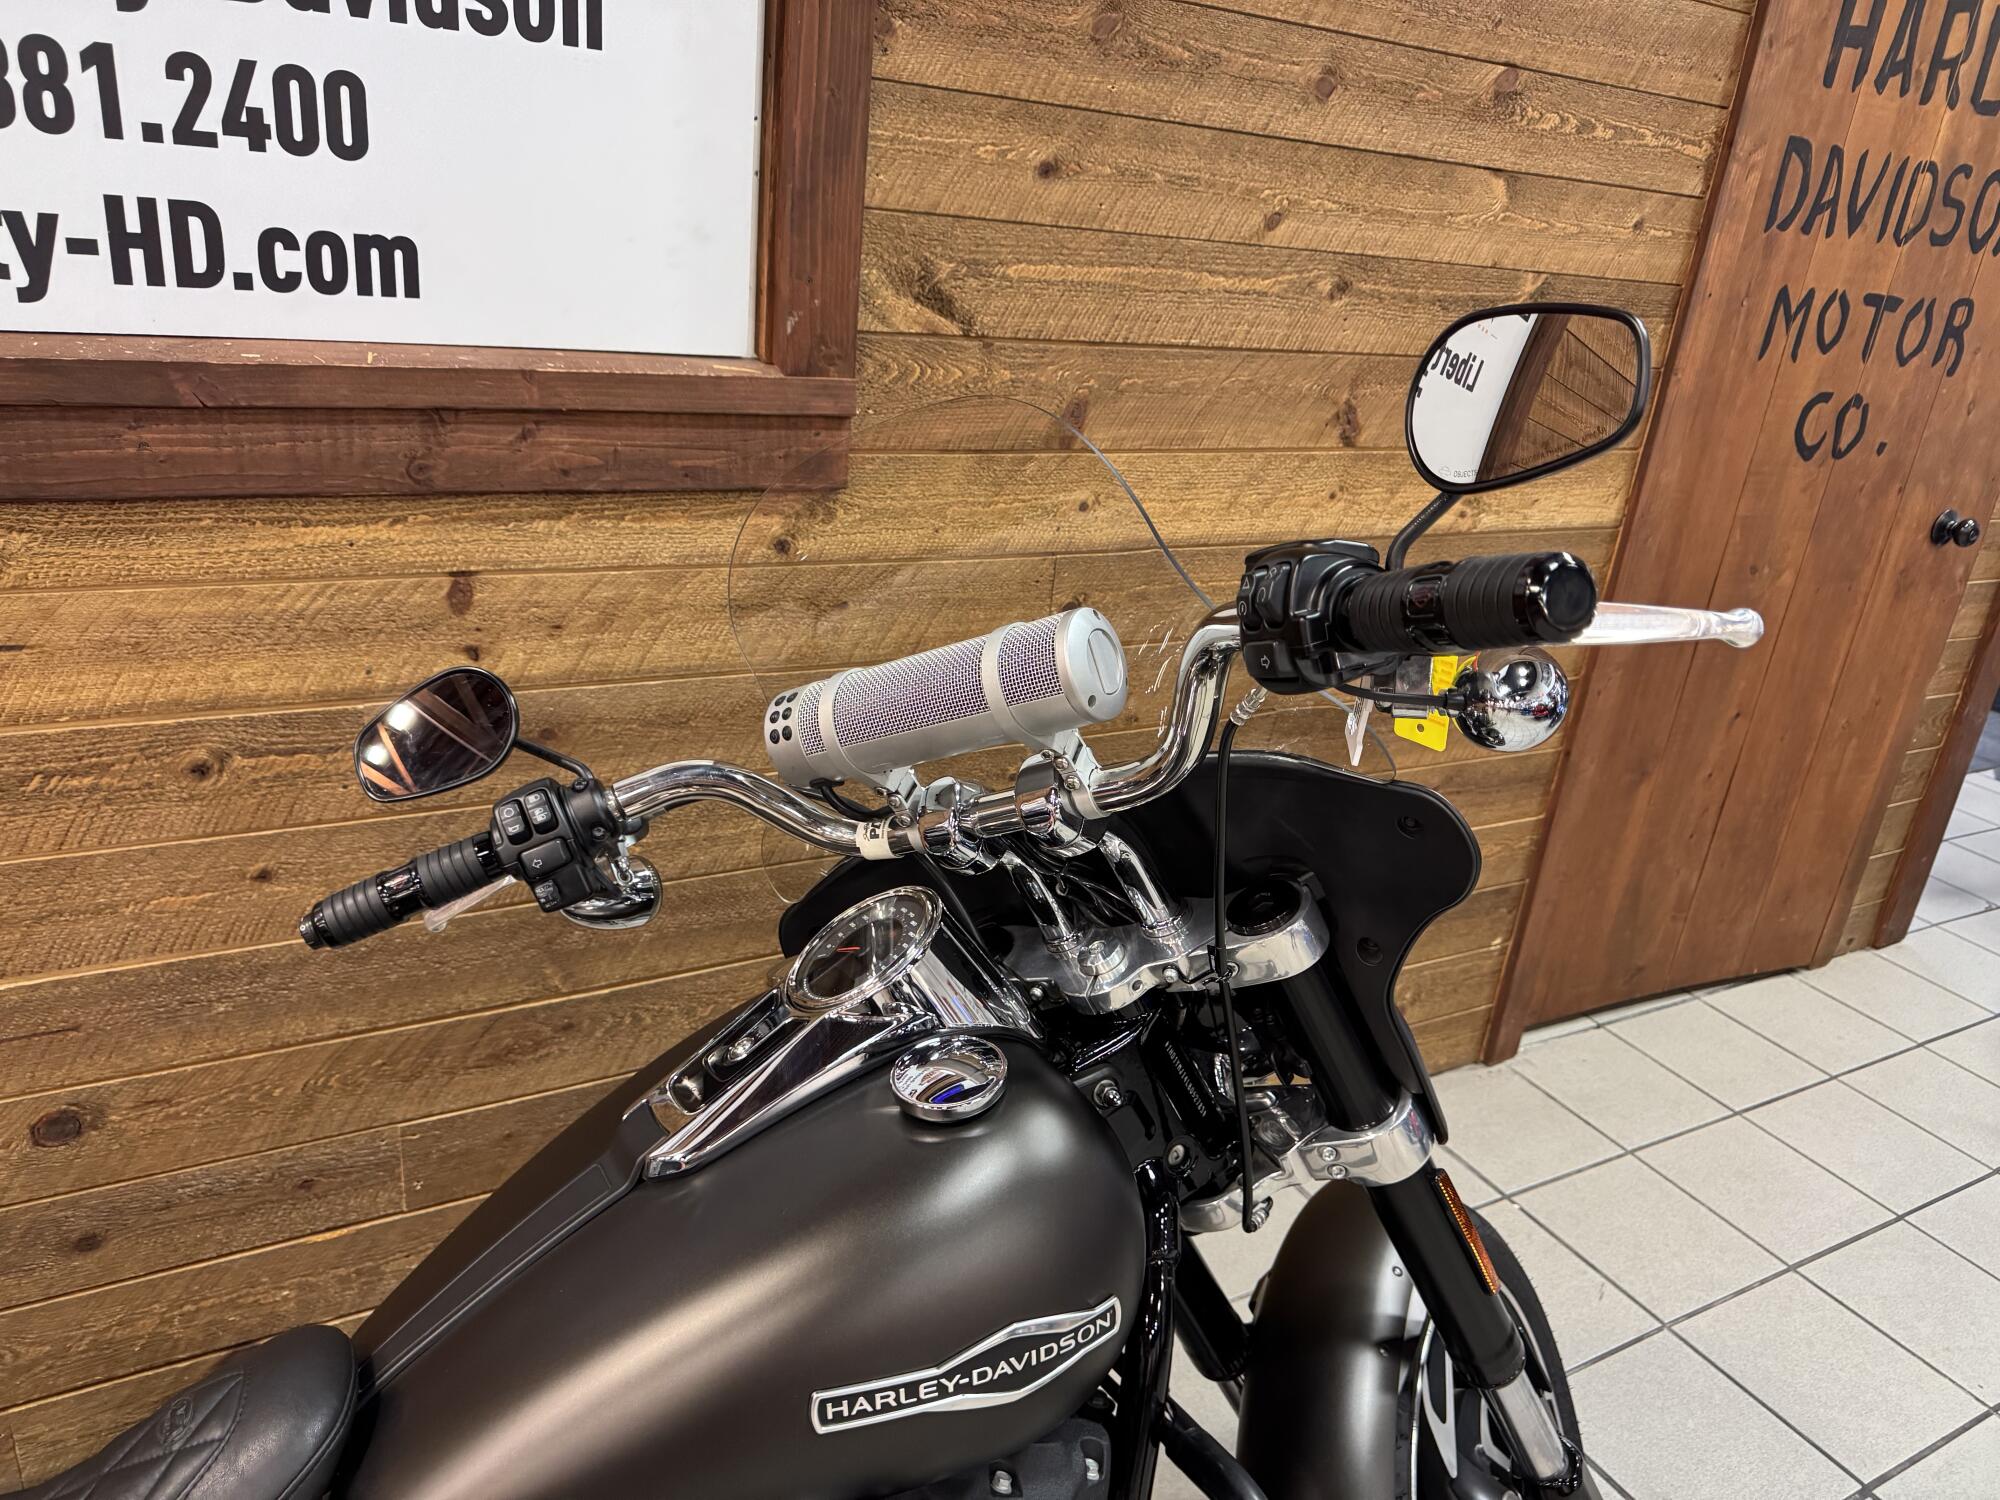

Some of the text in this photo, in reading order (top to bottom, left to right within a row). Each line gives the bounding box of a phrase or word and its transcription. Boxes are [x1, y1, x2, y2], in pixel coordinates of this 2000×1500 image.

[1763, 135, 2000, 257] DAVIDSO
[1758, 284, 1974, 377] MOTOR
[1795, 392, 1888, 462] CO.
[826, 1312, 1112, 1420] HARLEY-DAVIDSON
